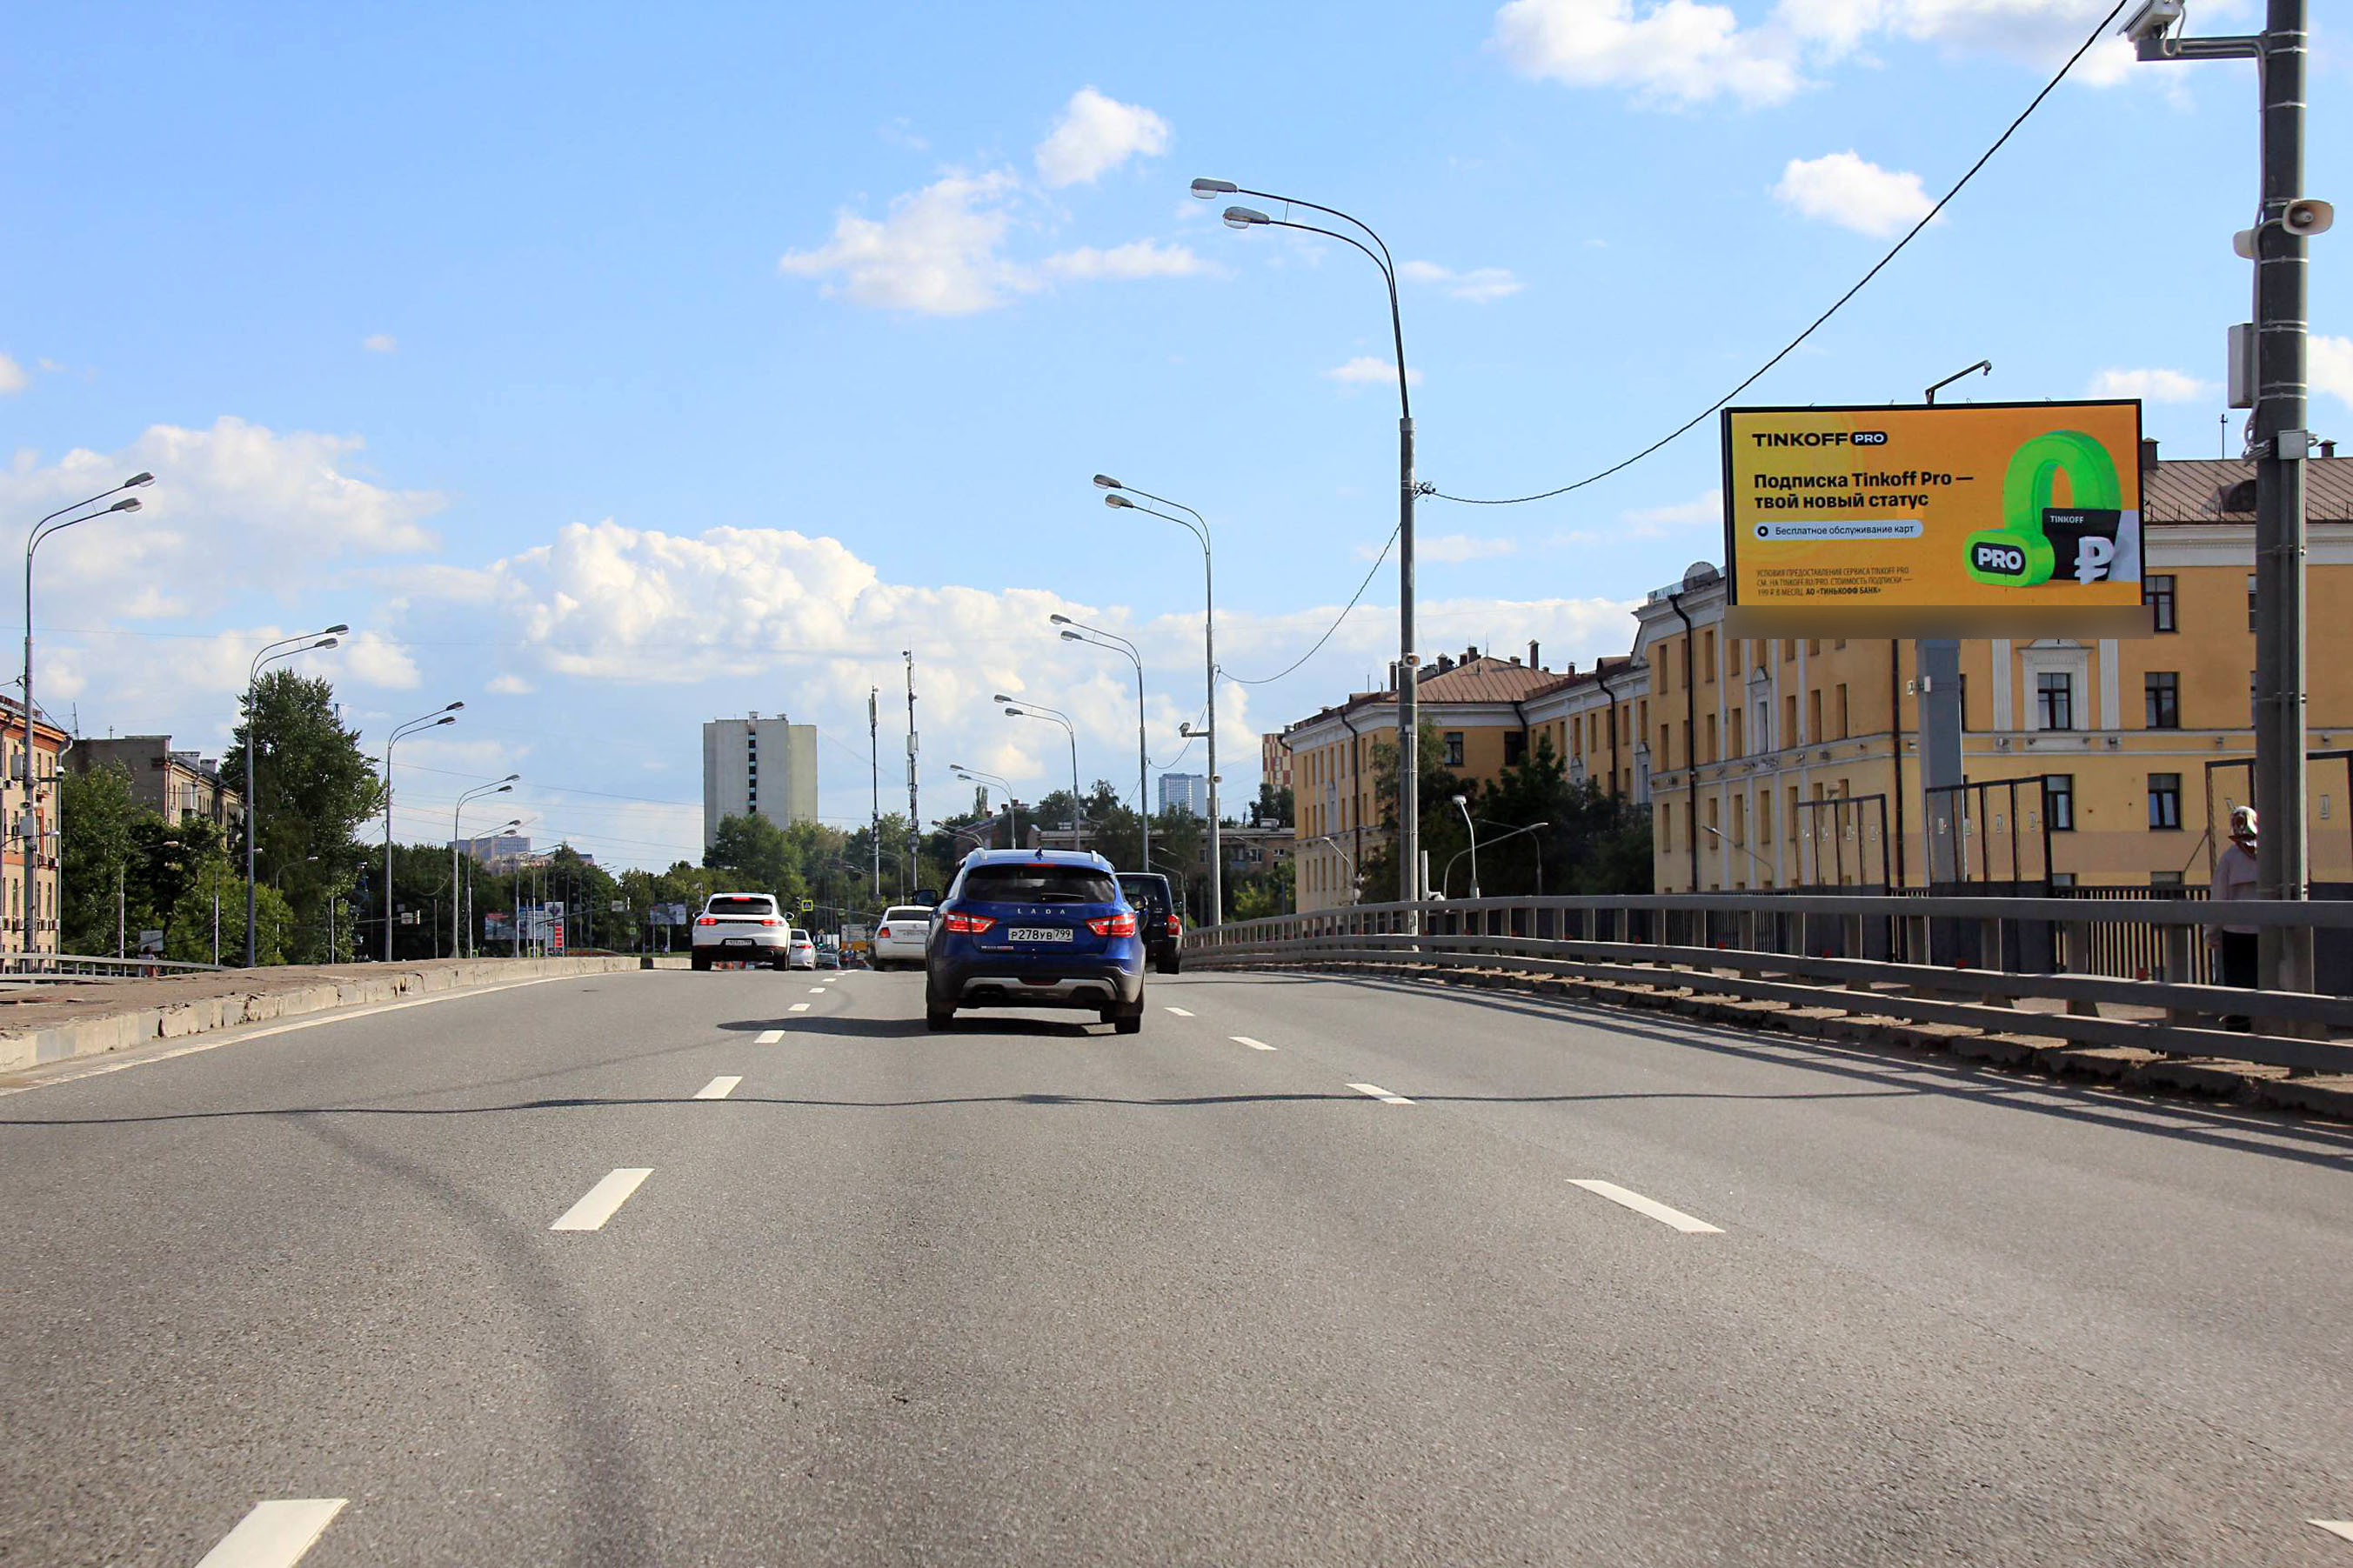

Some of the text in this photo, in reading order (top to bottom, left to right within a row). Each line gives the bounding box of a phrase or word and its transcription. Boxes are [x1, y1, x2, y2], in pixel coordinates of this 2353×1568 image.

[1752, 432, 1884, 447] TINKOFF PRO
[1754, 474, 1848, 490] Подписка
[1851, 470, 1917, 487] Tinkoff
[1921, 470, 1952, 485] Pro
[1755, 492, 1929, 510] твой новый статус
[2049, 515, 2084, 524] TINKOFF
[1775, 525, 1915, 536] Бесплатное обслуживание карт
[1977, 547, 2022, 570] PRO
[1806, 587, 1815, 596] АО
